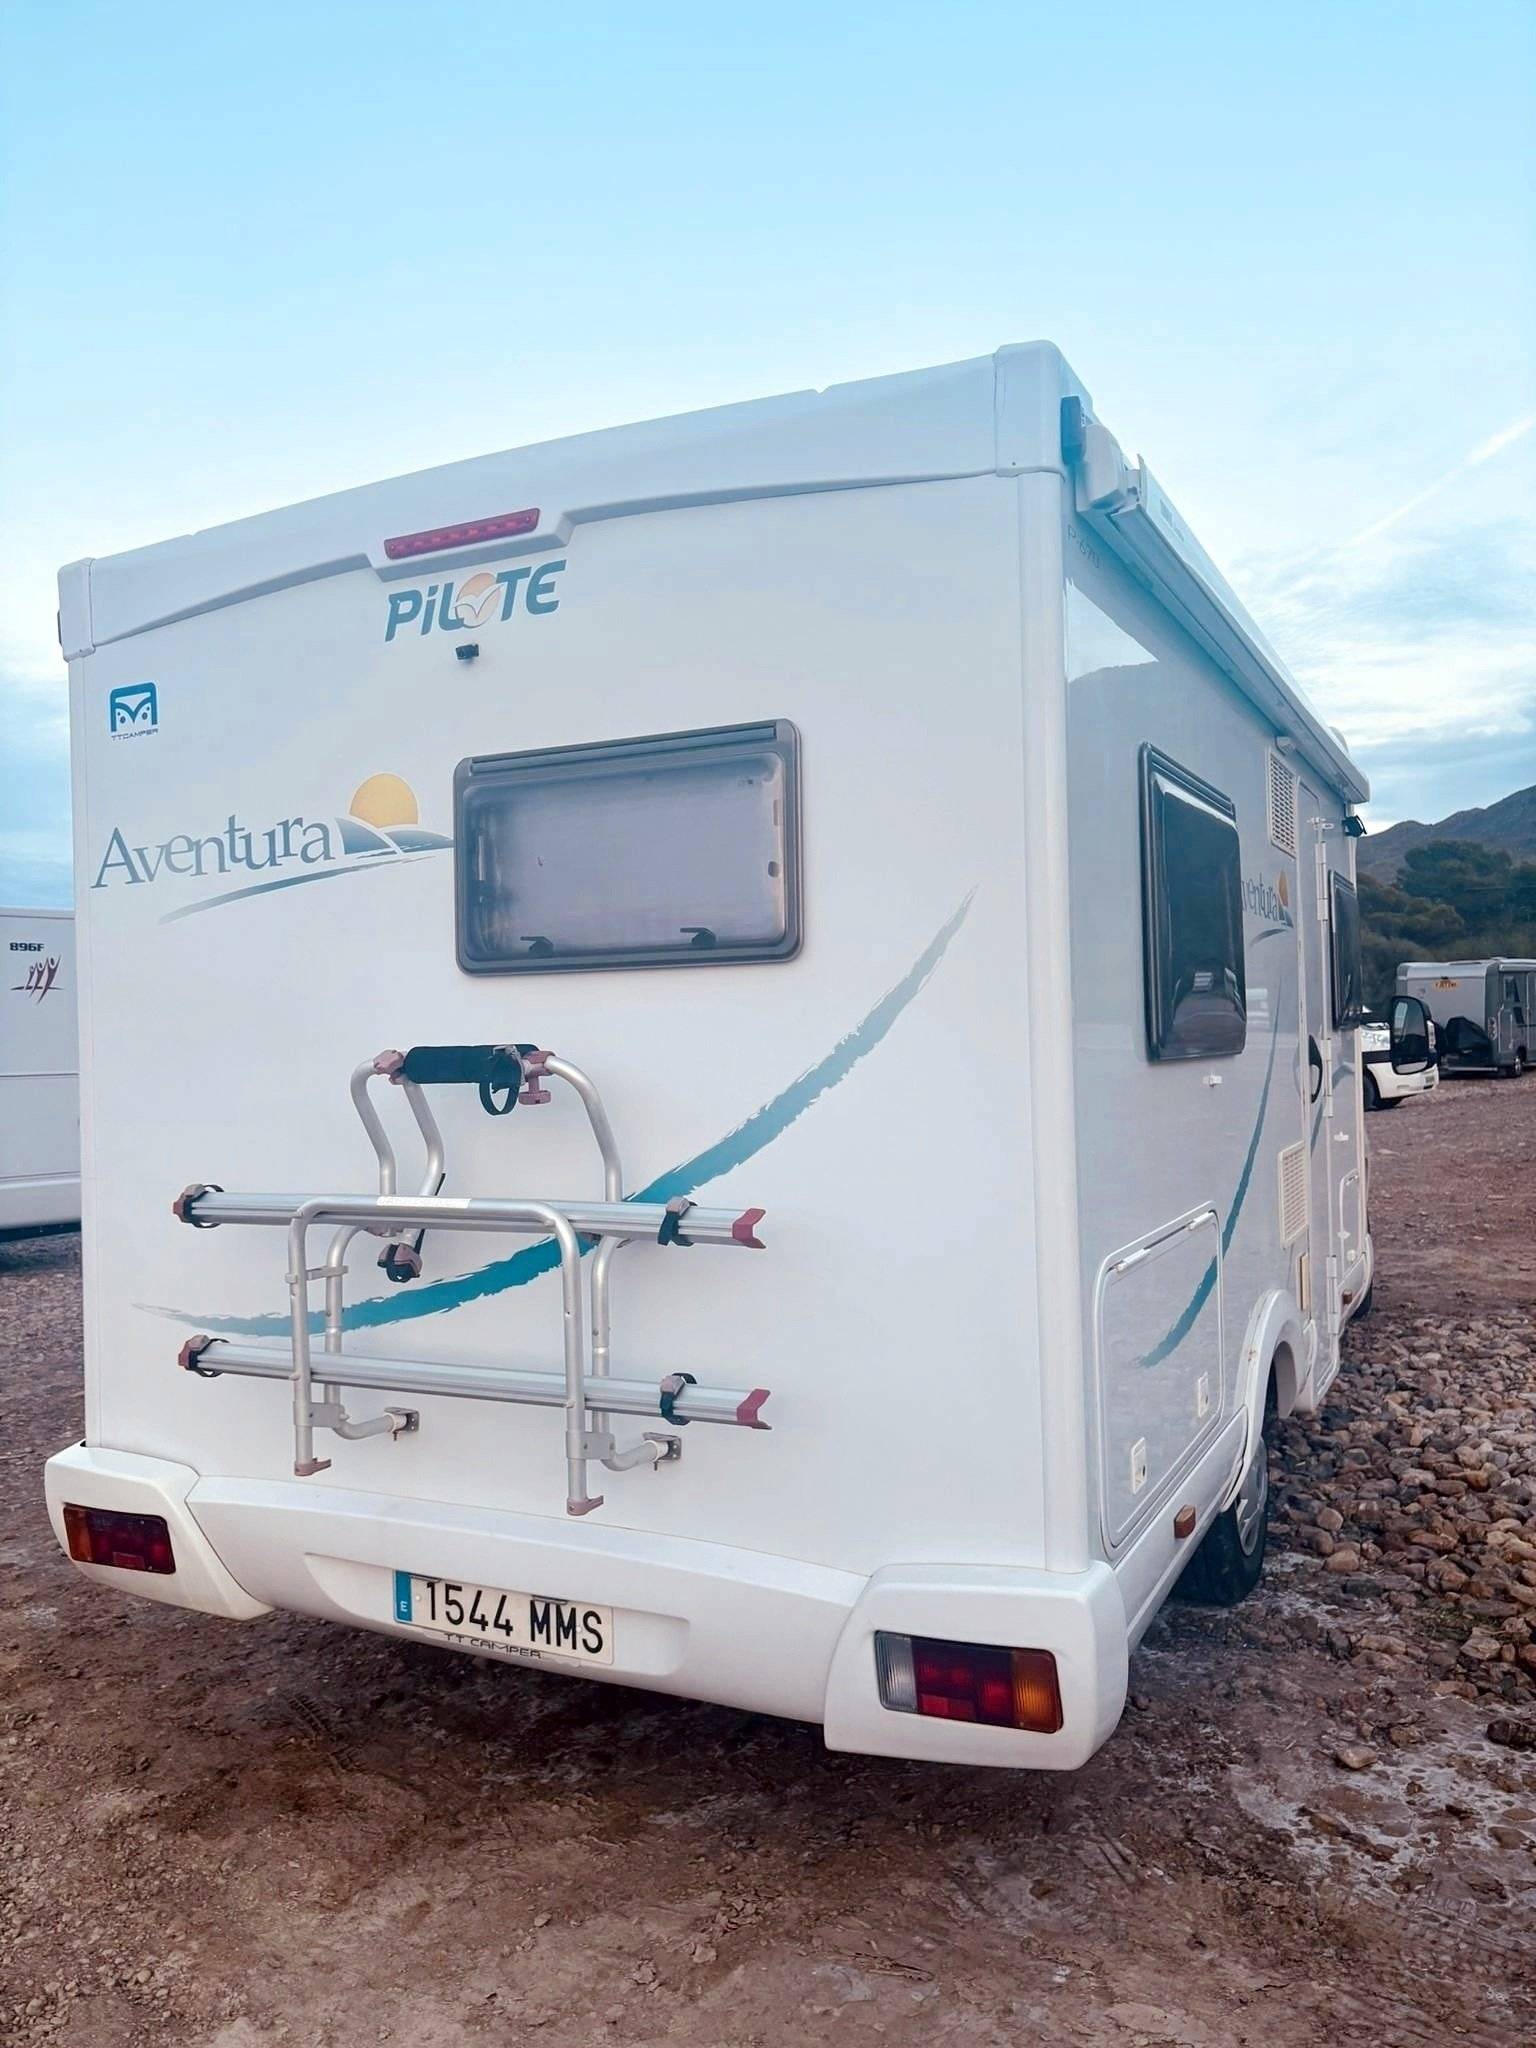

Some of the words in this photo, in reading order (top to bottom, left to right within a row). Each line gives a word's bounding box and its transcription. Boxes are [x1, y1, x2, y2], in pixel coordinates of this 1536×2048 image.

[90, 814, 336, 889] Aventura
[1241, 872, 1280, 921] ventura
[9, 942, 45, 952] 896F
[401, 1600, 408, 1612] E
[426, 1581, 514, 1637] 1544
[529, 1599, 604, 1654] MMS
[443, 1632, 465, 1644] TT
[470, 1637, 542, 1660] CAMPER
